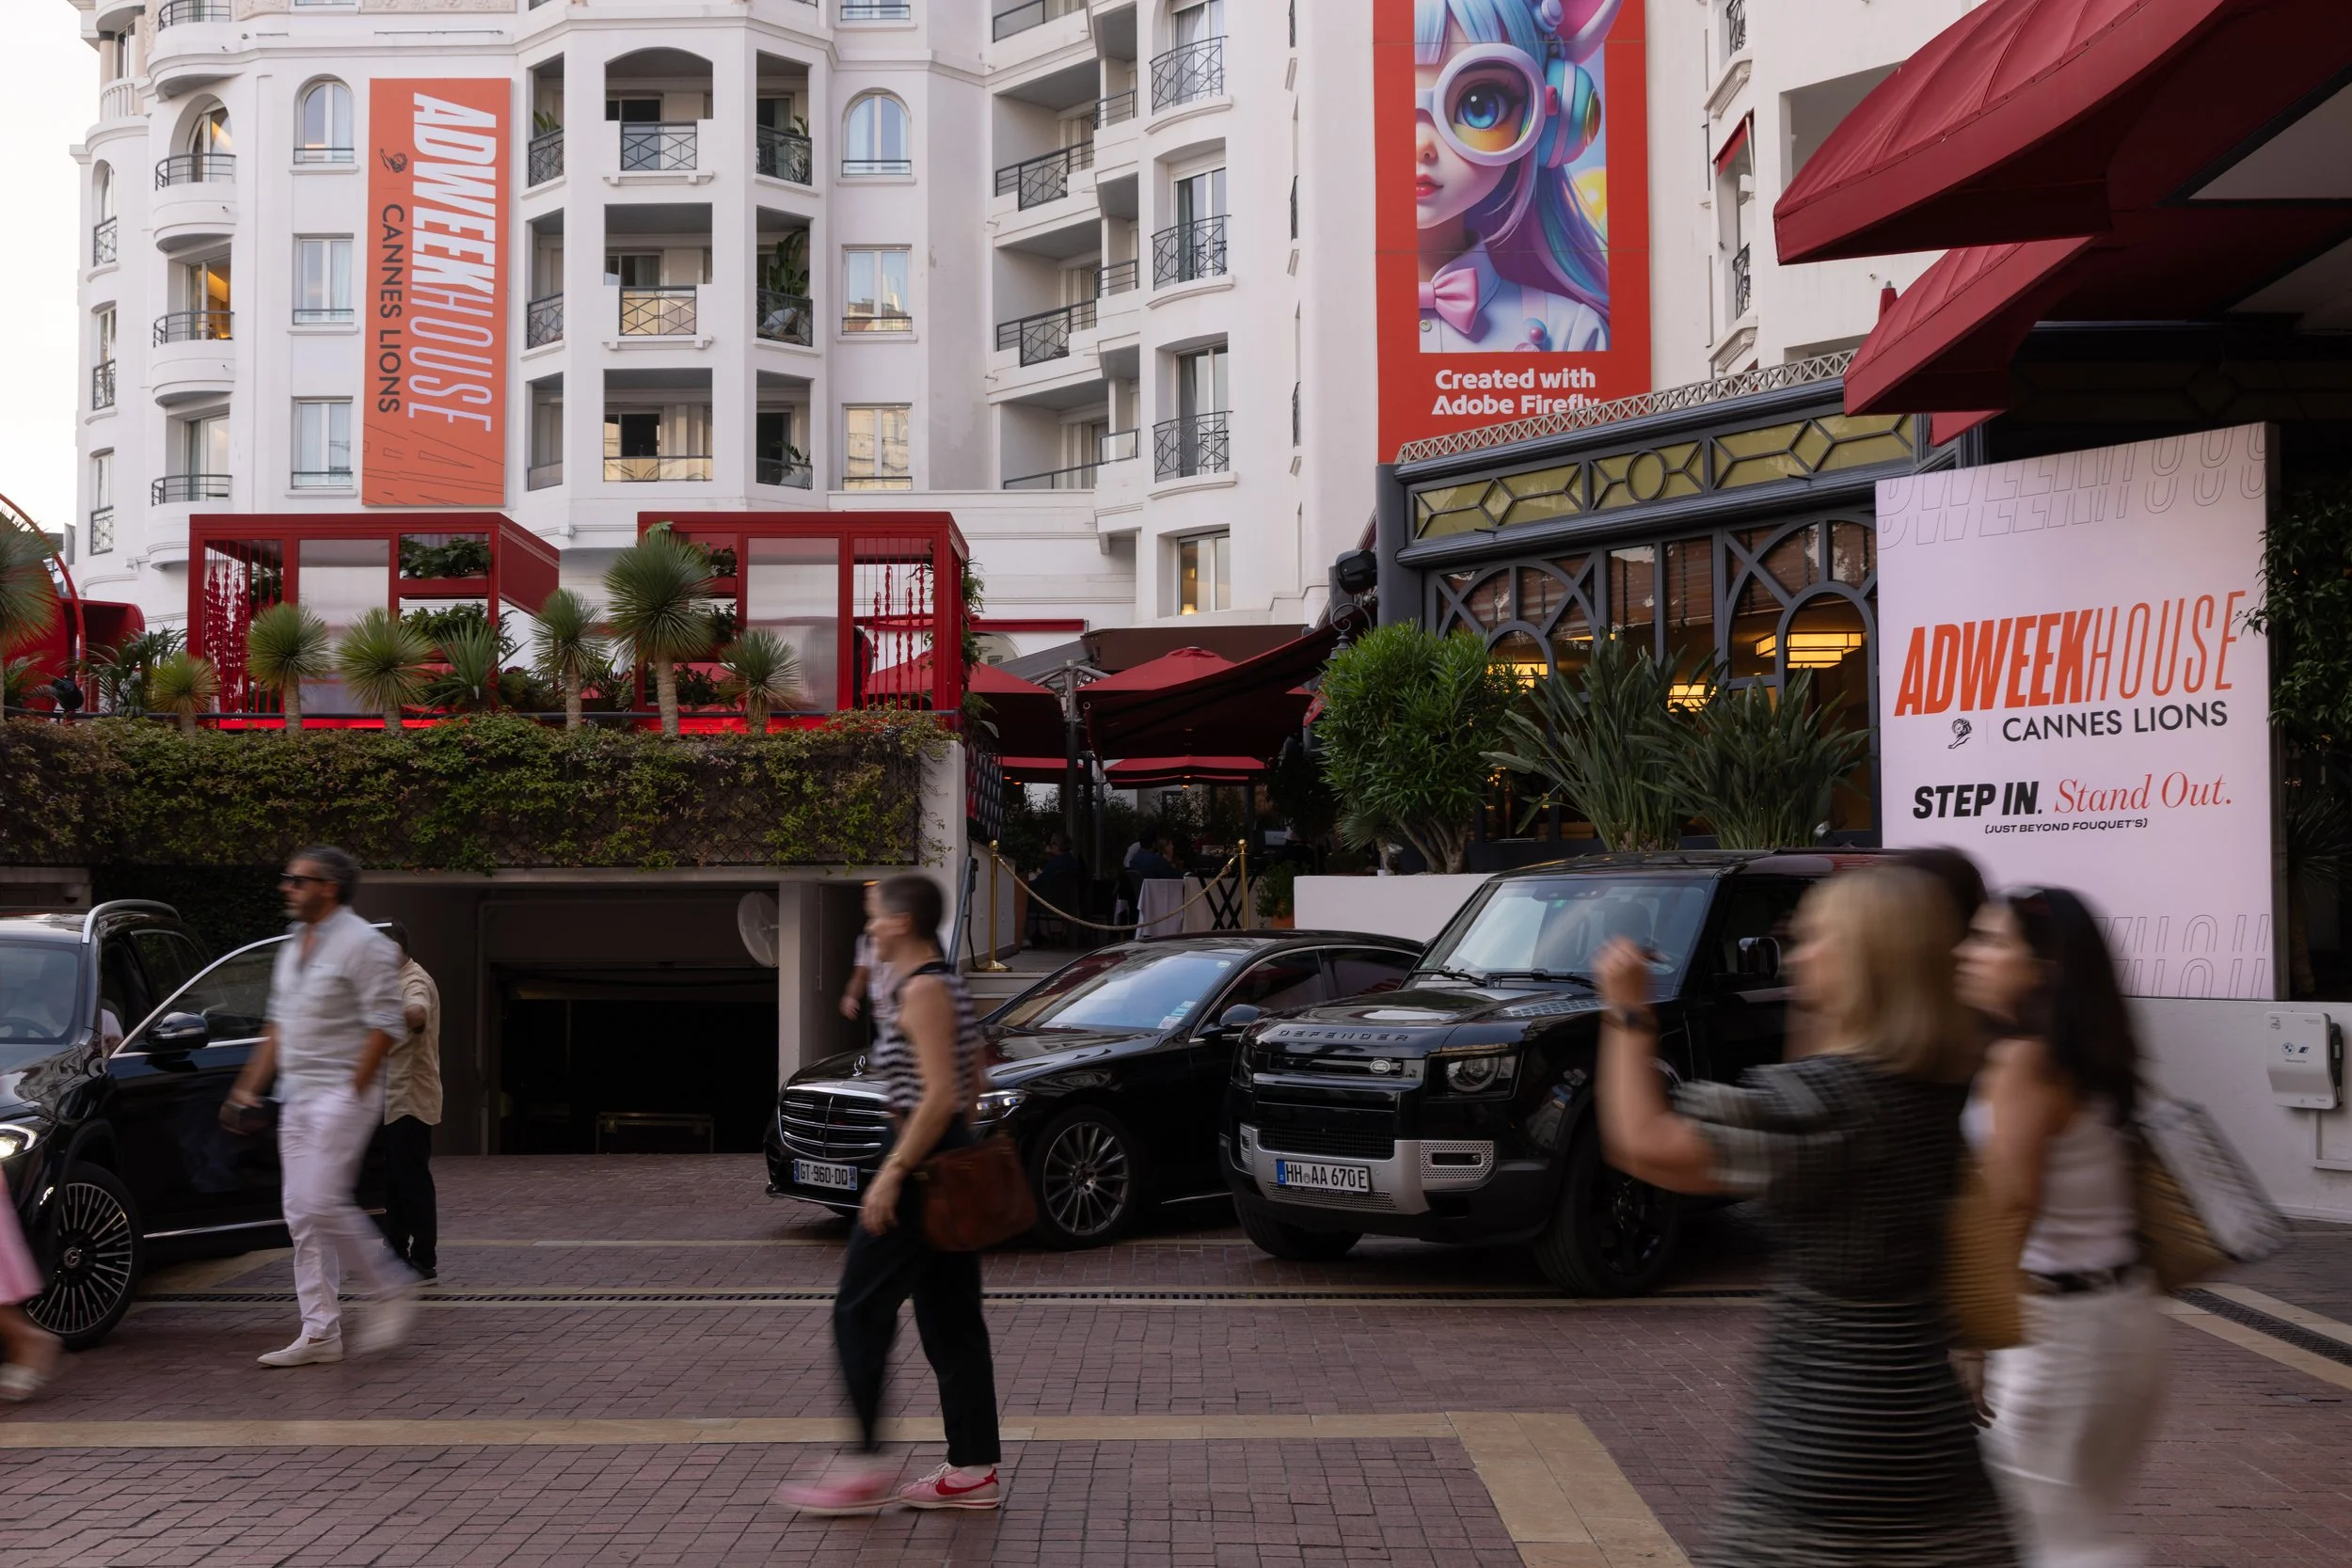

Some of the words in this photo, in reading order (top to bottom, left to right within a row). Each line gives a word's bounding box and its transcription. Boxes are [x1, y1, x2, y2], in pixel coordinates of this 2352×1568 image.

[379, 203, 405, 319] CANNES
[408, 92, 497, 432] ADWEEKHOUSE
[378, 329, 403, 413] LIONS
[1435, 368, 1534, 389] Created
[1539, 368, 1597, 388] with
[1431, 394, 1515, 415] Adobe
[1894, 590, 2246, 717] ADWEEKHOUSE
[2002, 709, 2122, 742] CANNES
[2134, 700, 2229, 734] LIONS
[1913, 783, 1996, 819] STEP
[2001, 781, 2043, 816] IN.
[2055, 773, 2153, 814] Stand
[2161, 771, 2233, 809] Out.
[1984, 824, 2017, 834] (JUST
[2019, 822, 2070, 832] BEYOND
[1279, 1030, 1409, 1041] DEFENDER
[1285, 1164, 1303, 1183] HH
[1311, 1165, 1327, 1185] AA
